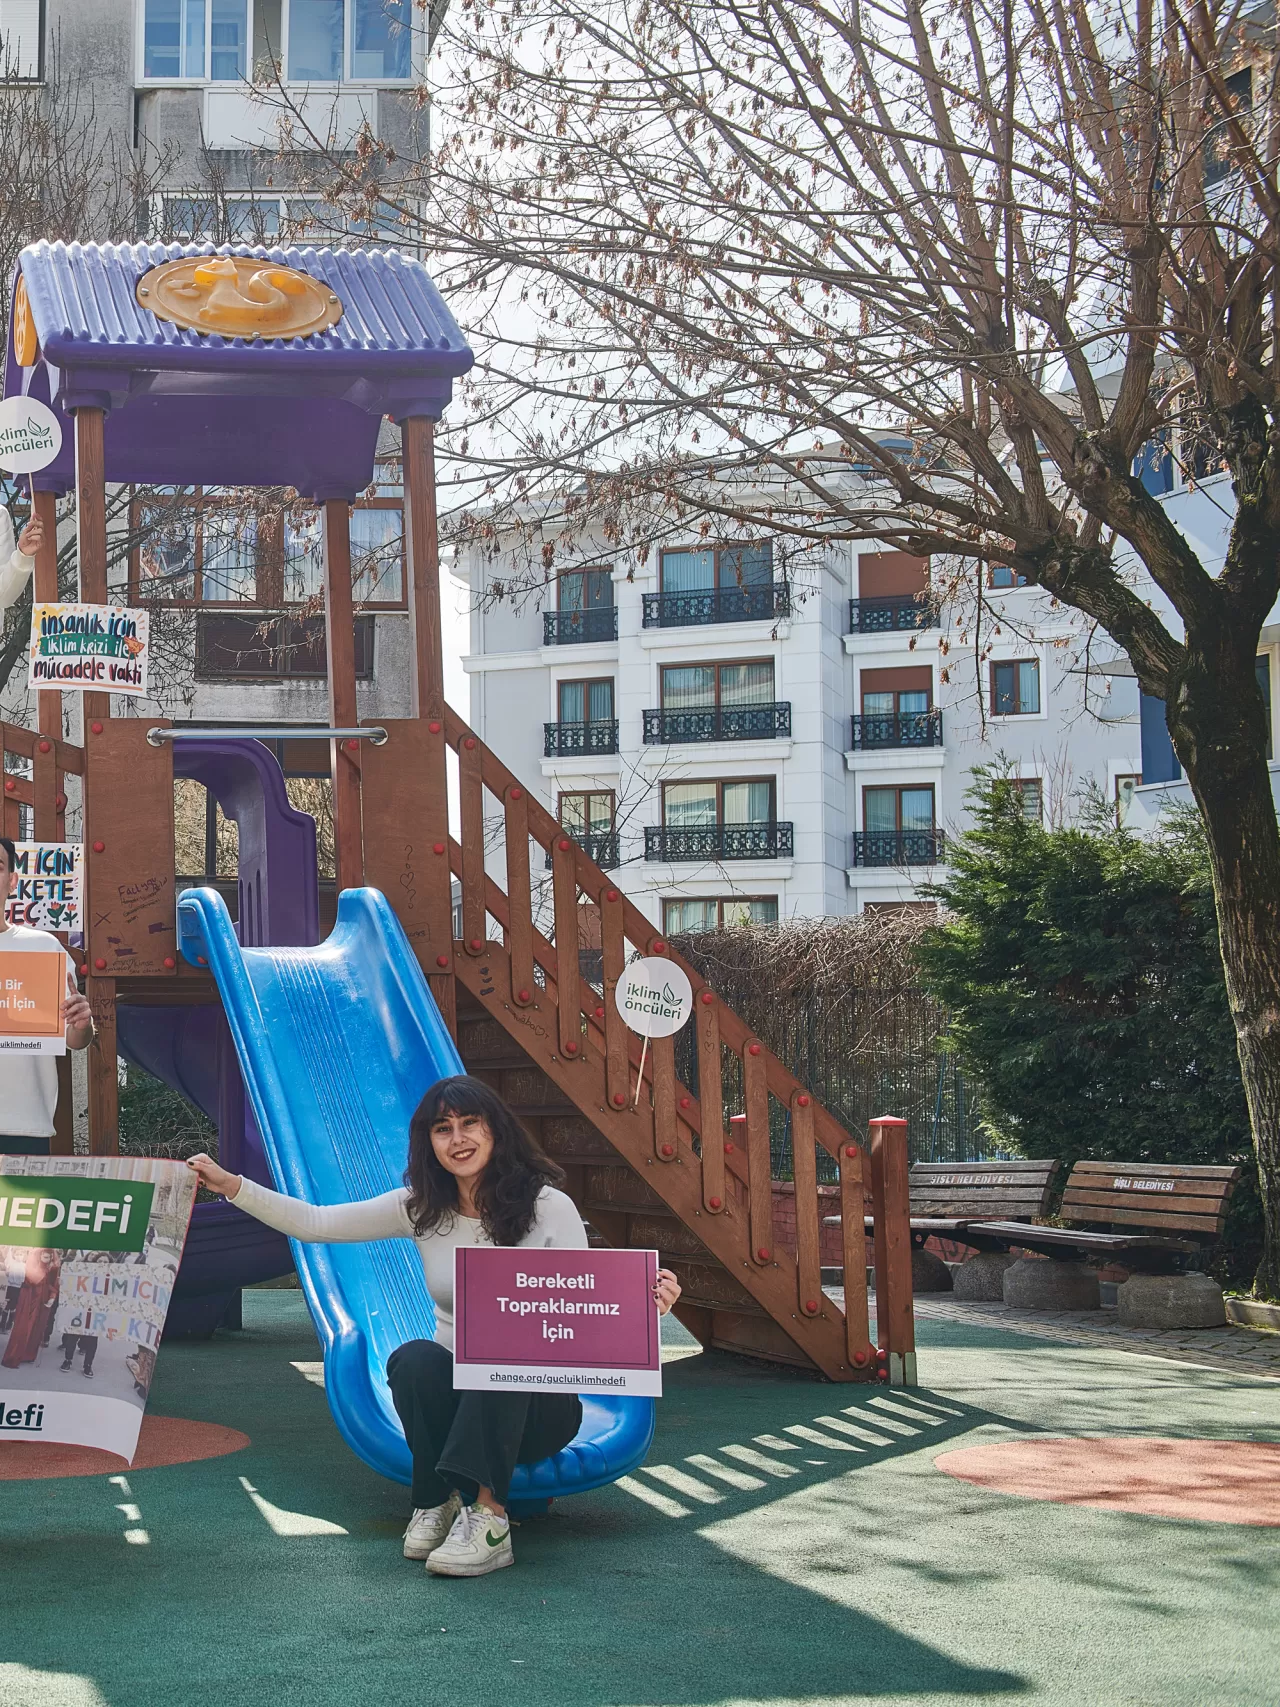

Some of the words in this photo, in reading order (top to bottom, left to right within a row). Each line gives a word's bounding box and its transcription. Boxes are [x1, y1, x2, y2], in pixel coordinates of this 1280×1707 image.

[5, 979, 23, 991] Bir
[627, 982, 661, 1001] iklim
[13, 995, 35, 1011] İçin
[624, 997, 682, 1019] öncüleri
[516, 1272, 595, 1290] Bereketli
[496, 1297, 620, 1316] Topraklarımız
[542, 1320, 574, 1343] İçin
[489, 1372, 626, 1386] change.org/gucluiklimhedefi
